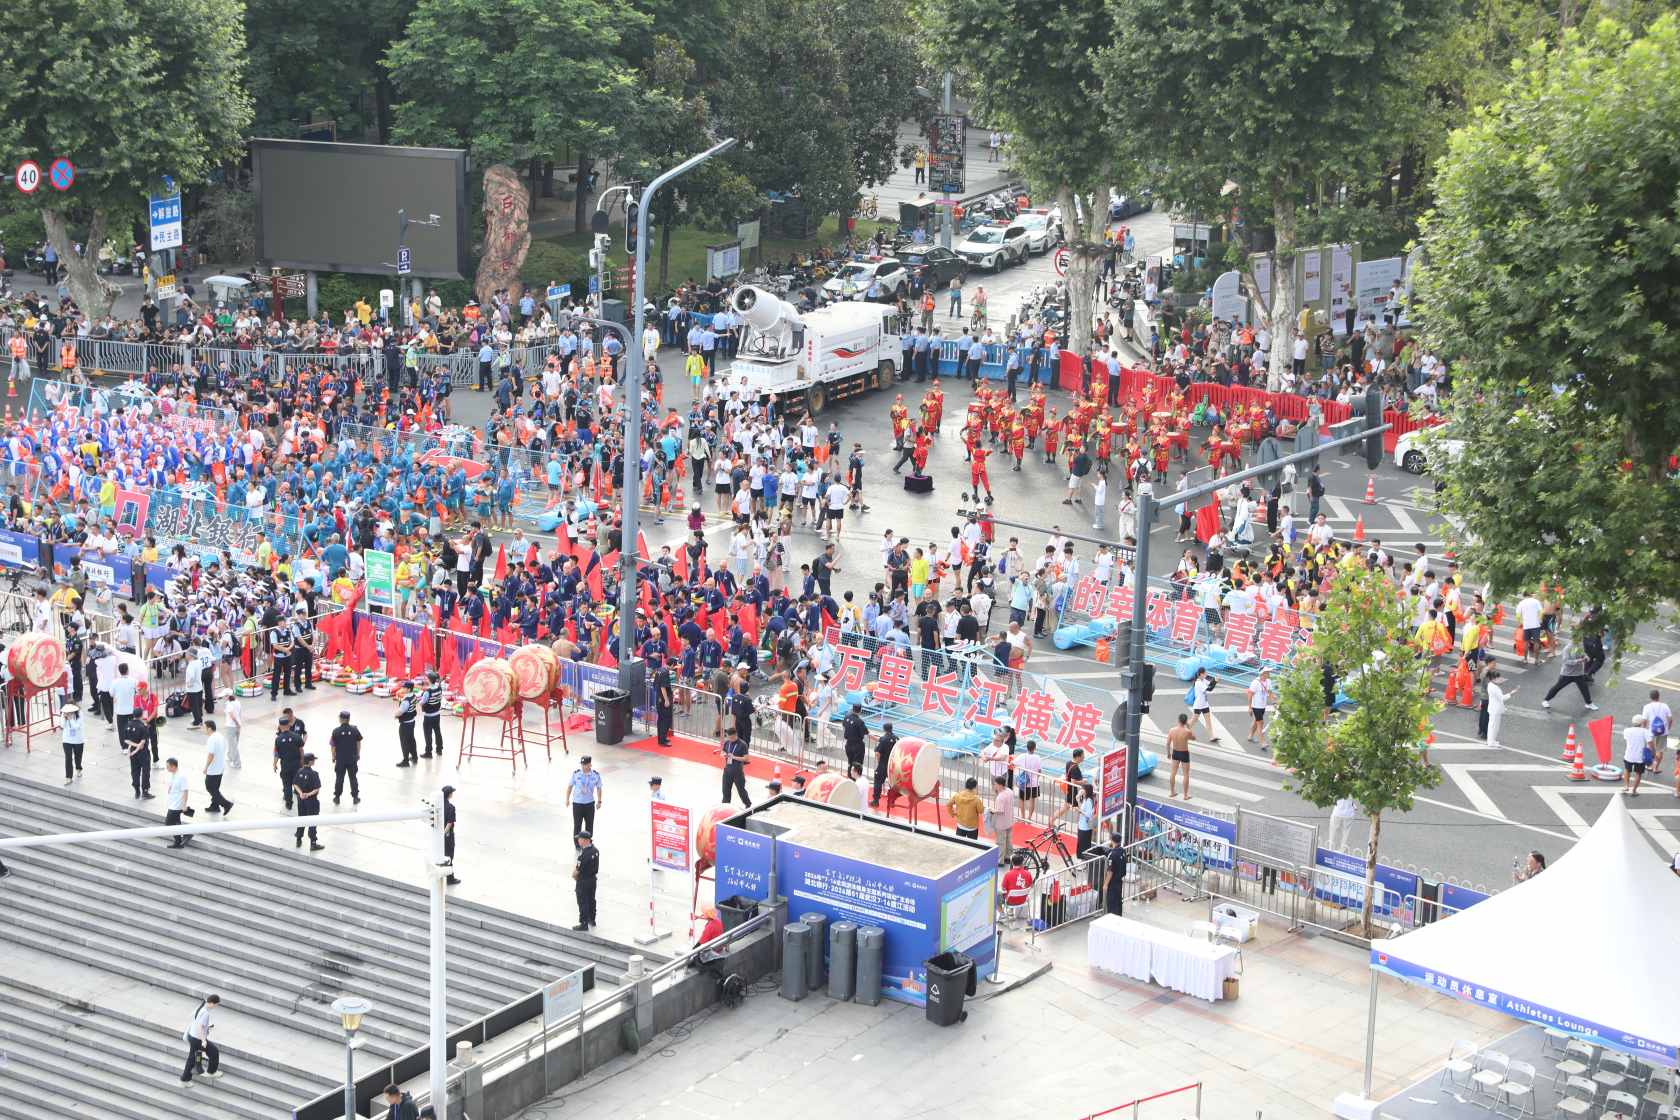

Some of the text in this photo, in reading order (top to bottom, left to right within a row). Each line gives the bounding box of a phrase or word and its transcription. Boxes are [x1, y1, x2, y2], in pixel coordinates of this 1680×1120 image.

[21, 170, 36, 184] 40
[159, 229, 179, 243] 民主路
[401, 251, 408, 262] P
[829, 643, 1104, 755] 万里长江横渡
[1424, 971, 1599, 1036] 运动员休息室 Athletes Lounge
